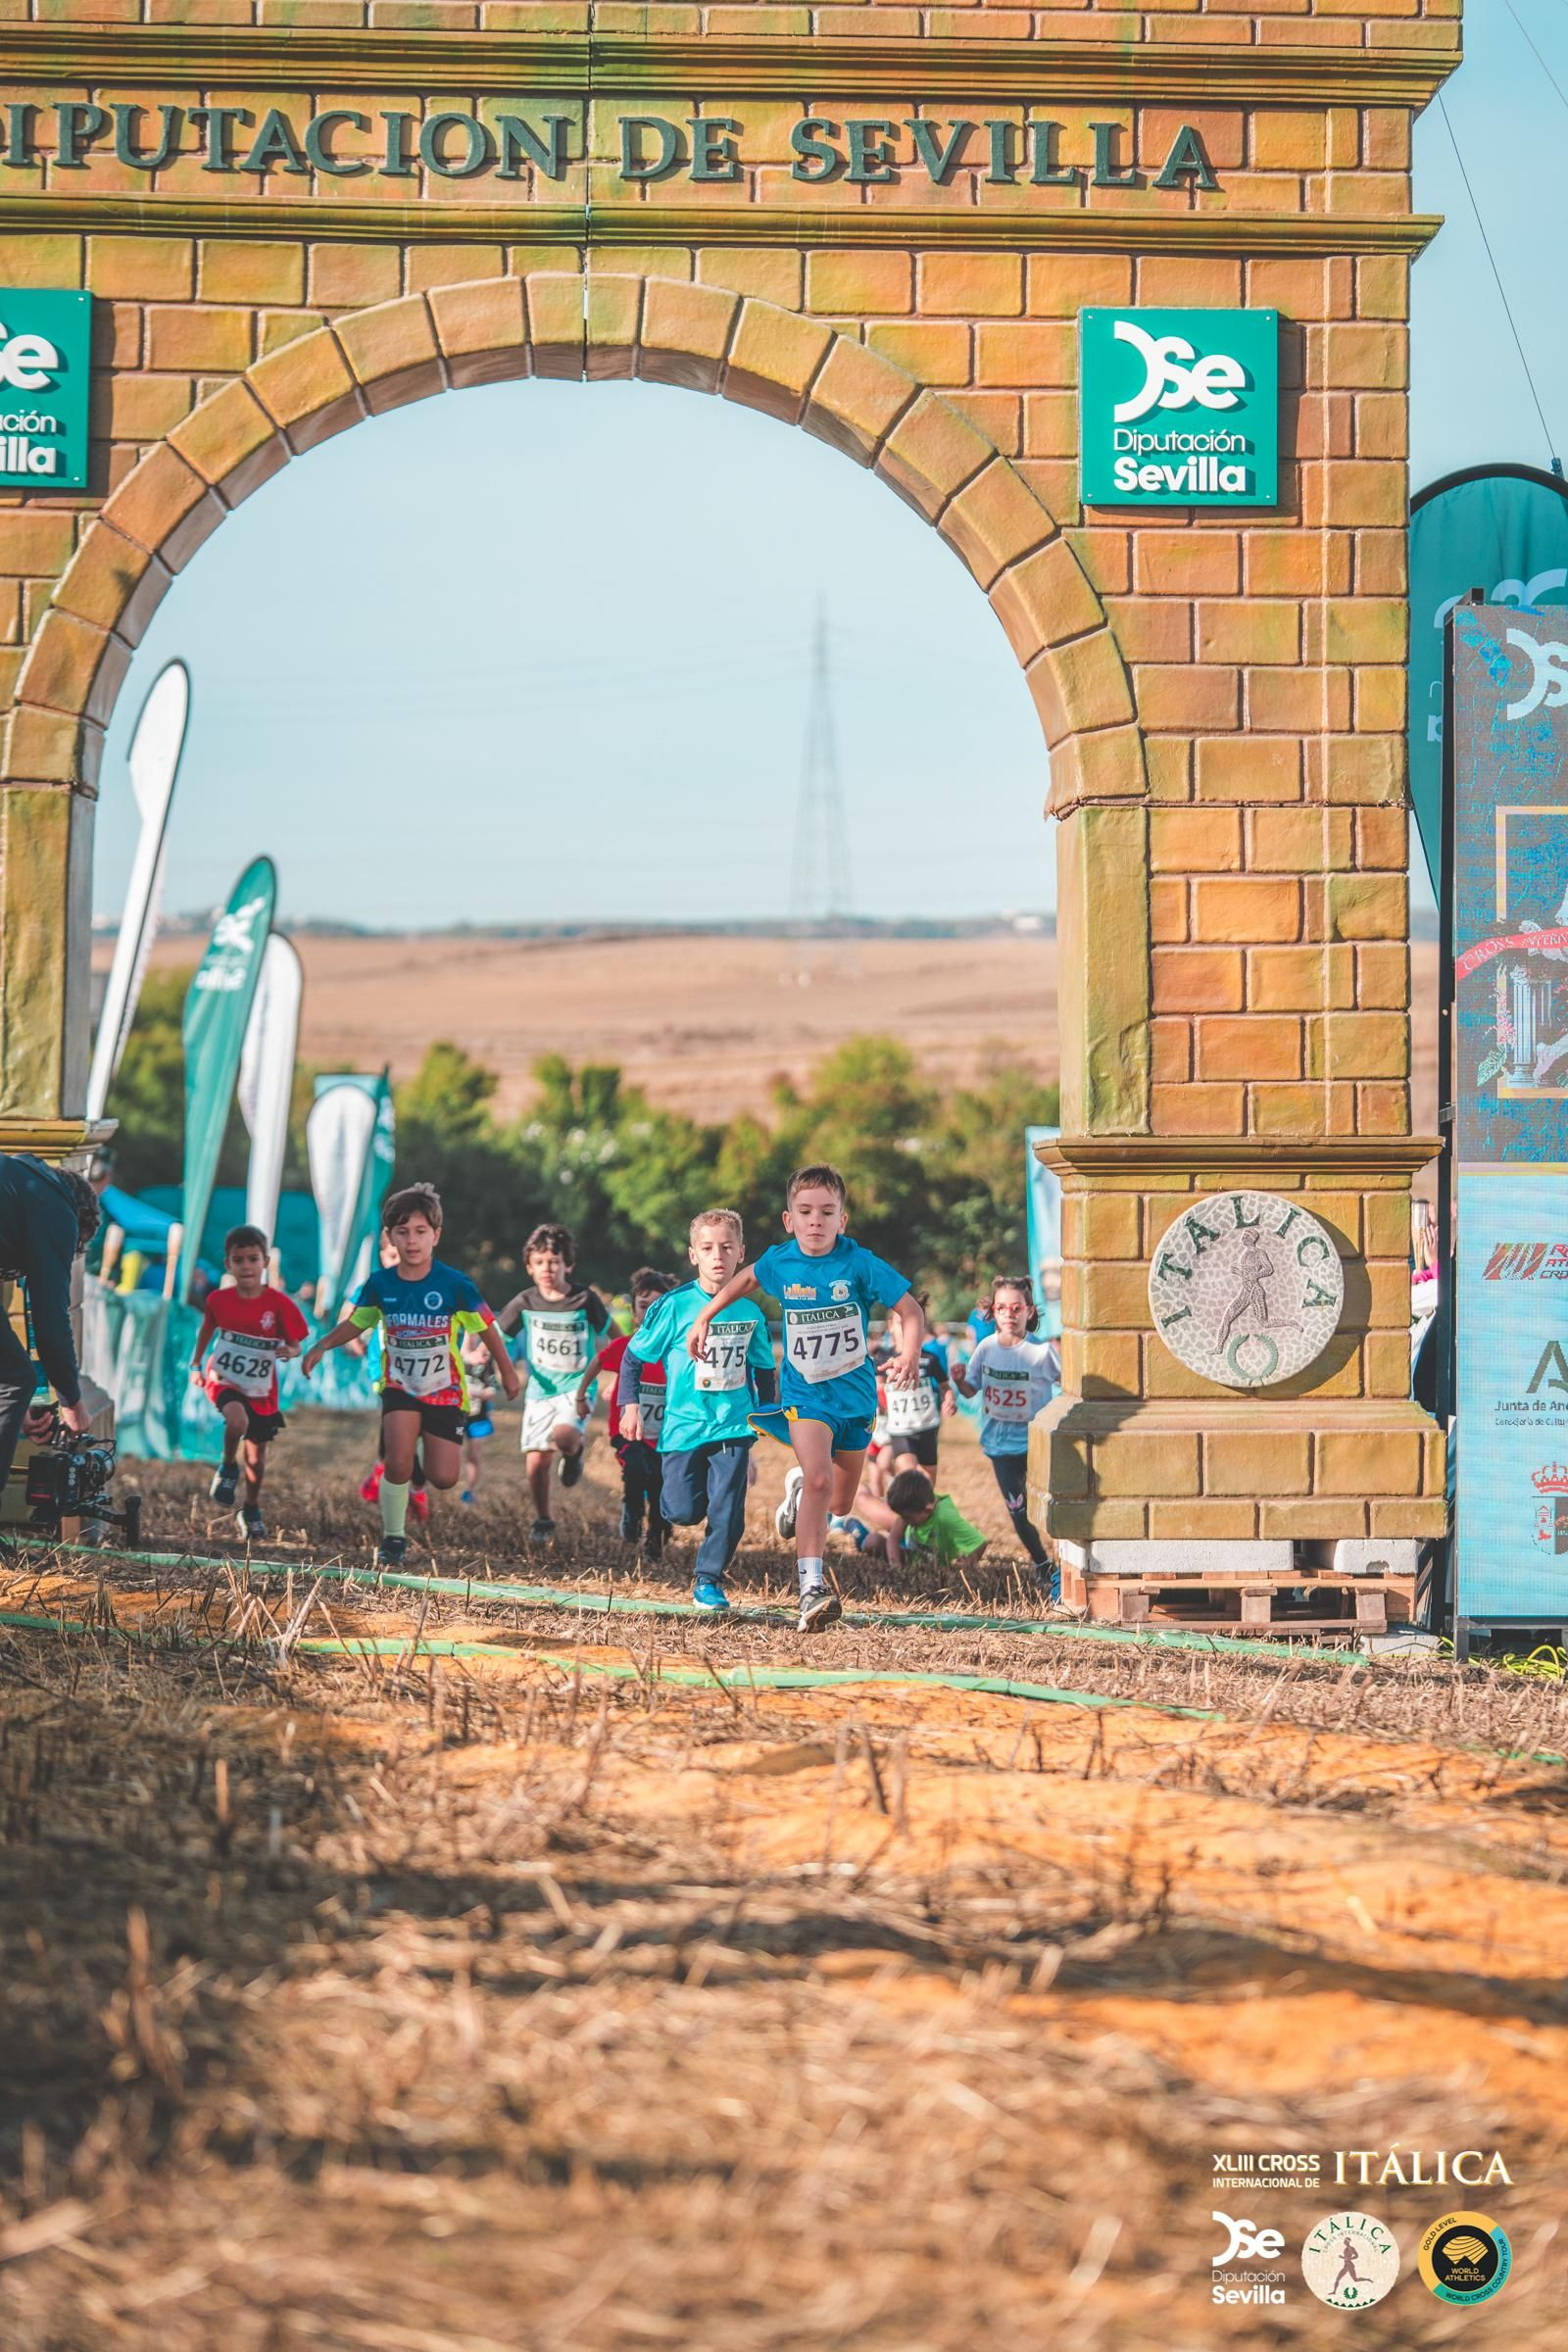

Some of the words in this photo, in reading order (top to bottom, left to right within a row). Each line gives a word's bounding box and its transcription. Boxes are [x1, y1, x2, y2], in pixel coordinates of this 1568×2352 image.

[0, 103, 572, 179] IPUTACION
[617, 116, 738, 181] DE
[790, 118, 1217, 190] SEVILLA
[1113, 428, 1246, 457] Diputación
[1113, 456, 1246, 492] Sevilla
[1157, 1196, 1338, 1329] ITALICA
[536, 1337, 583, 1356] 4661
[793, 1327, 859, 1360] 4775
[217, 1351, 271, 1378] 4628
[394, 1354, 445, 1377] 4772
[704, 1346, 746, 1368] 475
[892, 1395, 931, 1413] 4719
[985, 1385, 1027, 1407] 4525
[1494, 1400, 1529, 1411] Junta
[1532, 1399, 1546, 1411] de
